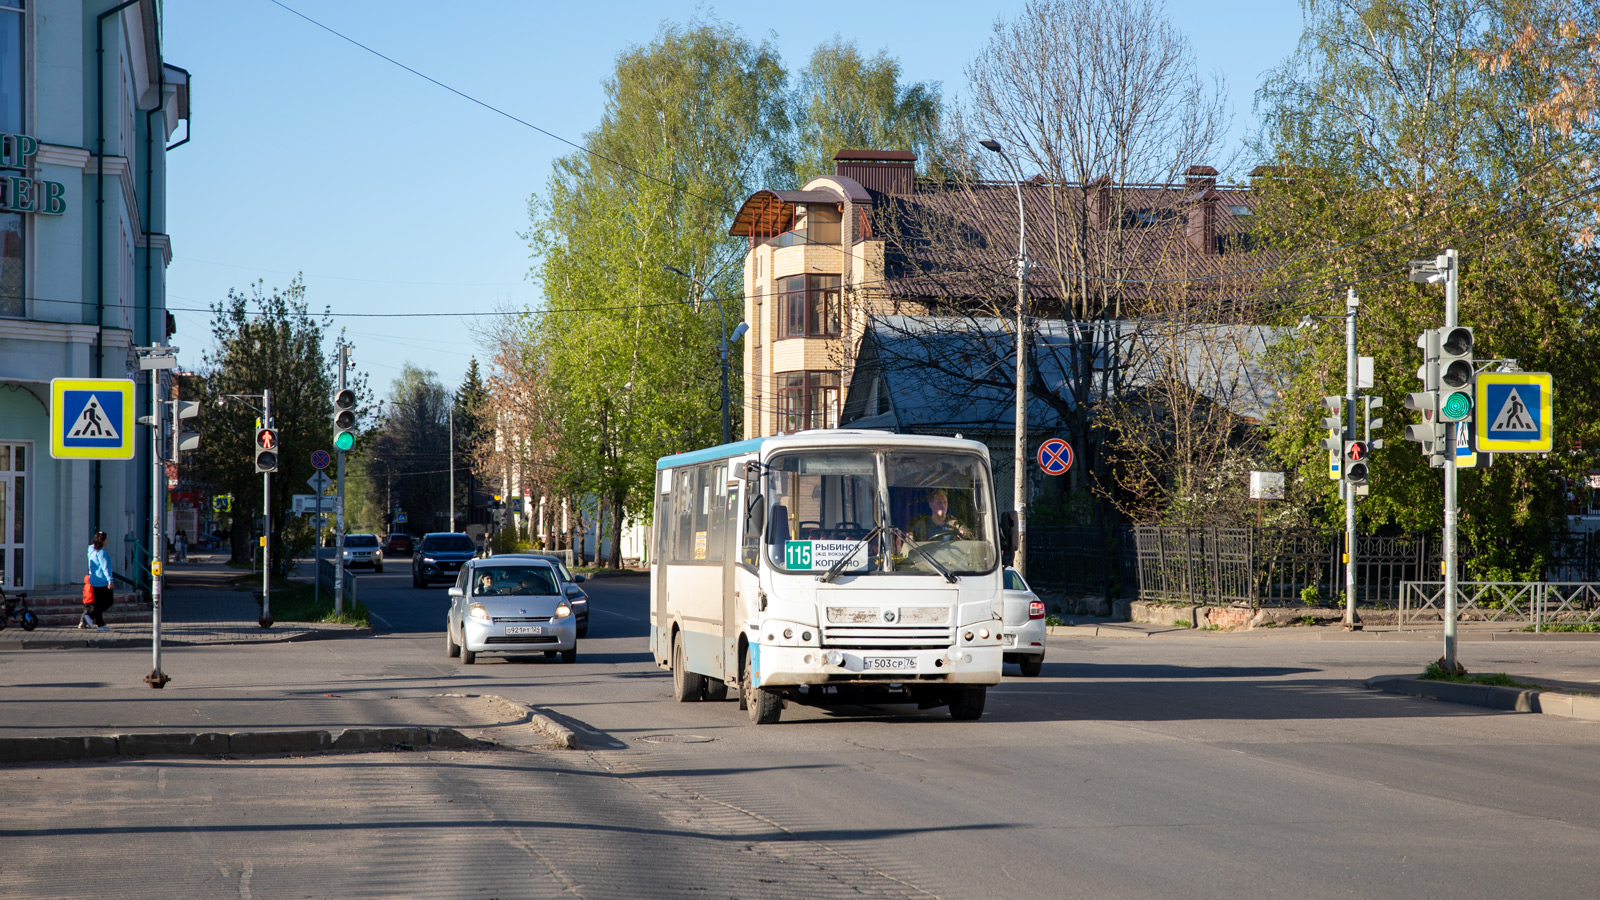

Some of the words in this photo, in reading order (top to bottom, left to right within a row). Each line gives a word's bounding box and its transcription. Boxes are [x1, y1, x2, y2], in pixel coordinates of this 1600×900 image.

[10, 177, 66, 214] ЕВ
[788, 546, 810, 565] 115
[906, 658, 915, 666] 76
